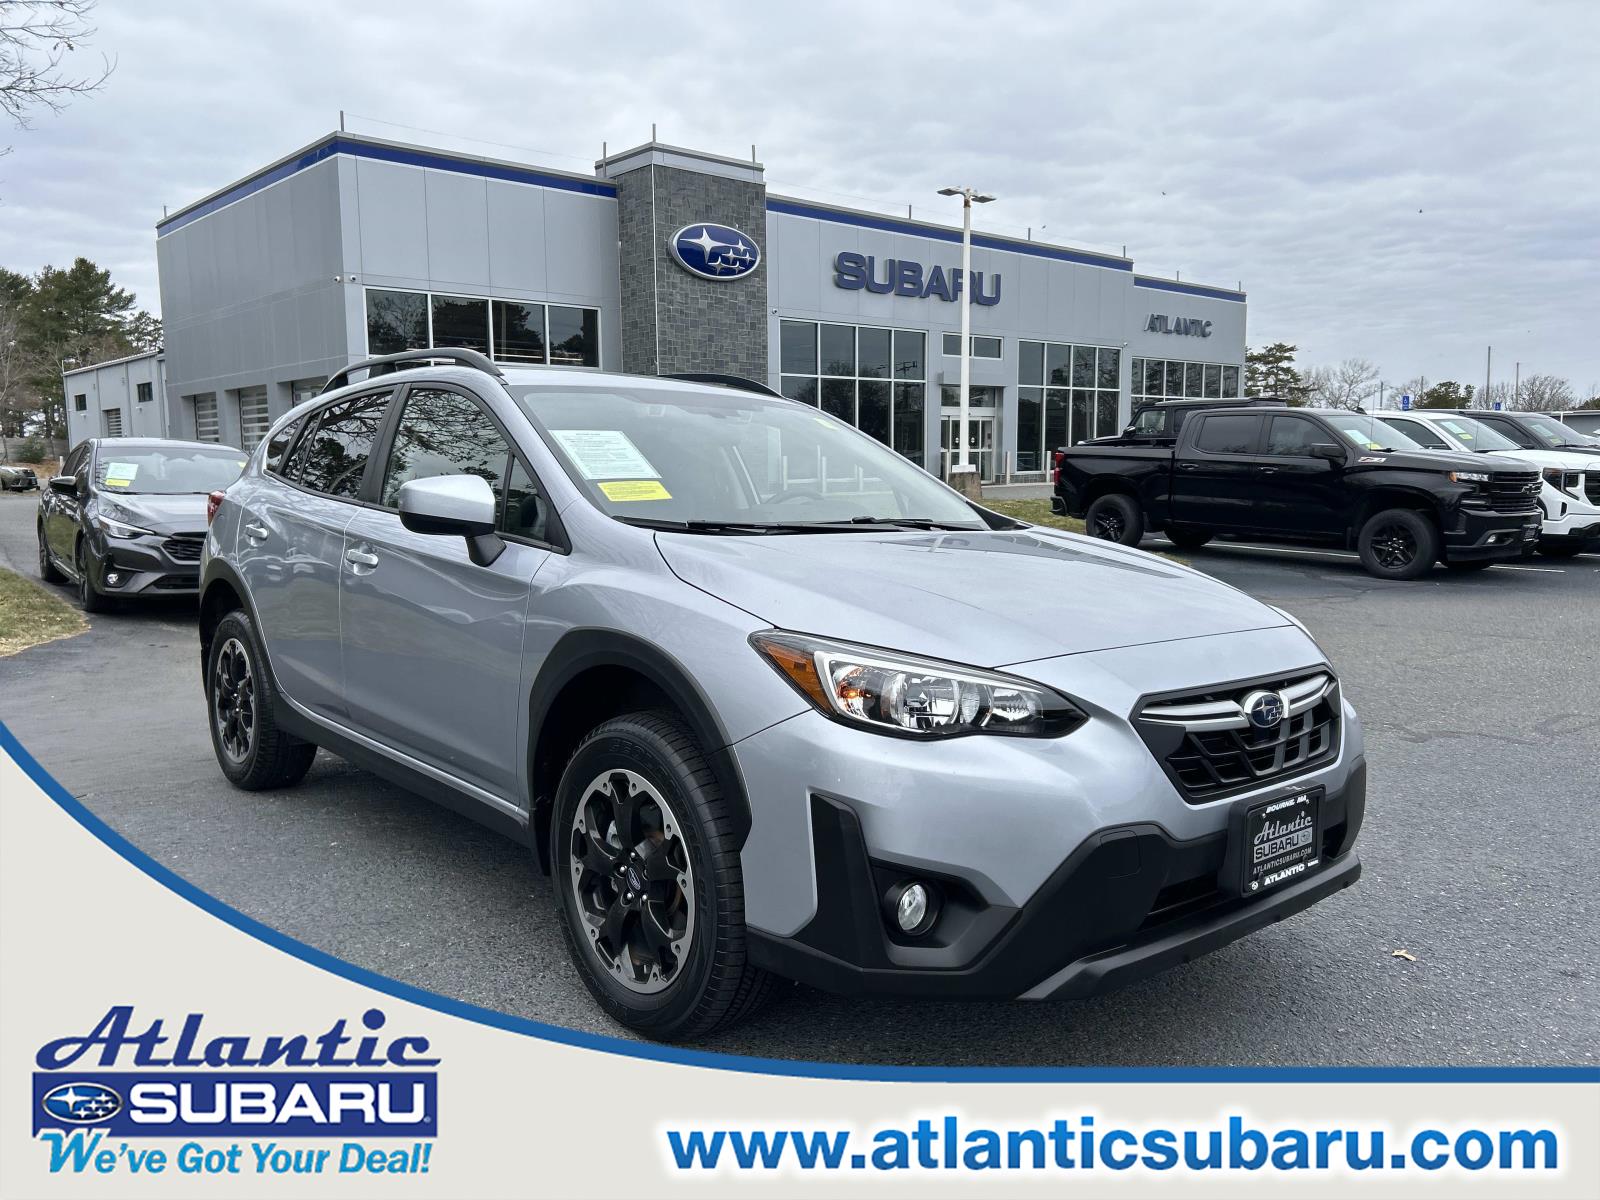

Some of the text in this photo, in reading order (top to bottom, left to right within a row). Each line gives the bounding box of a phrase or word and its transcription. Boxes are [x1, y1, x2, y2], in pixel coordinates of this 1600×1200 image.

[835, 251, 1002, 306] SUBARU
[1144, 313, 1213, 337] ATLANTIC
[1265, 798, 1295, 814] BOURNE
[1254, 810, 1313, 845] Atlantic
[1255, 834, 1300, 860] SUBARU
[1252, 846, 1313, 875] ATLANTICSUBARU.COM
[1264, 863, 1306, 886] ATLANTIC
